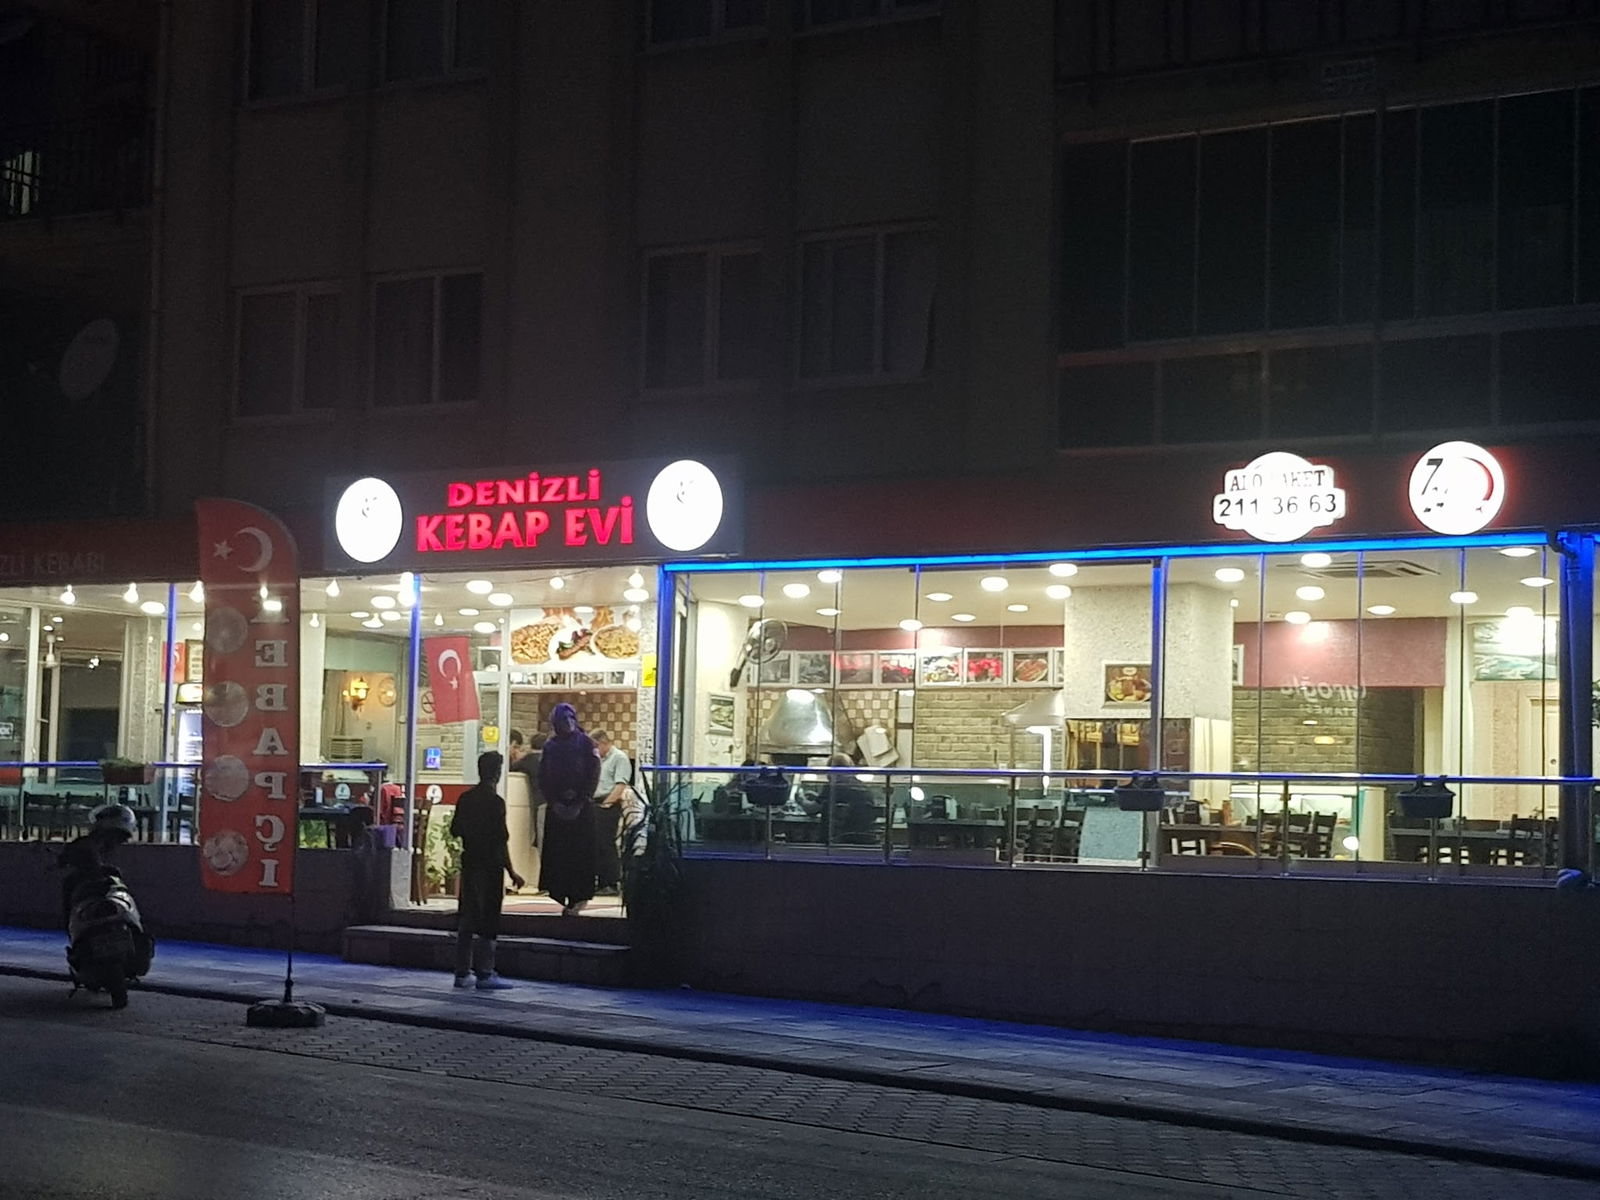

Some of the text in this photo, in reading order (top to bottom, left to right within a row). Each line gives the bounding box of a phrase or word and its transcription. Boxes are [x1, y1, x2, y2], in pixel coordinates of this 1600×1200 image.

[448, 468, 599, 508] DENİZLİ
[1270, 469, 1326, 489] KET
[1218, 493, 1337, 517] 211 36 63
[416, 495, 634, 552] KEBAP EVİ
